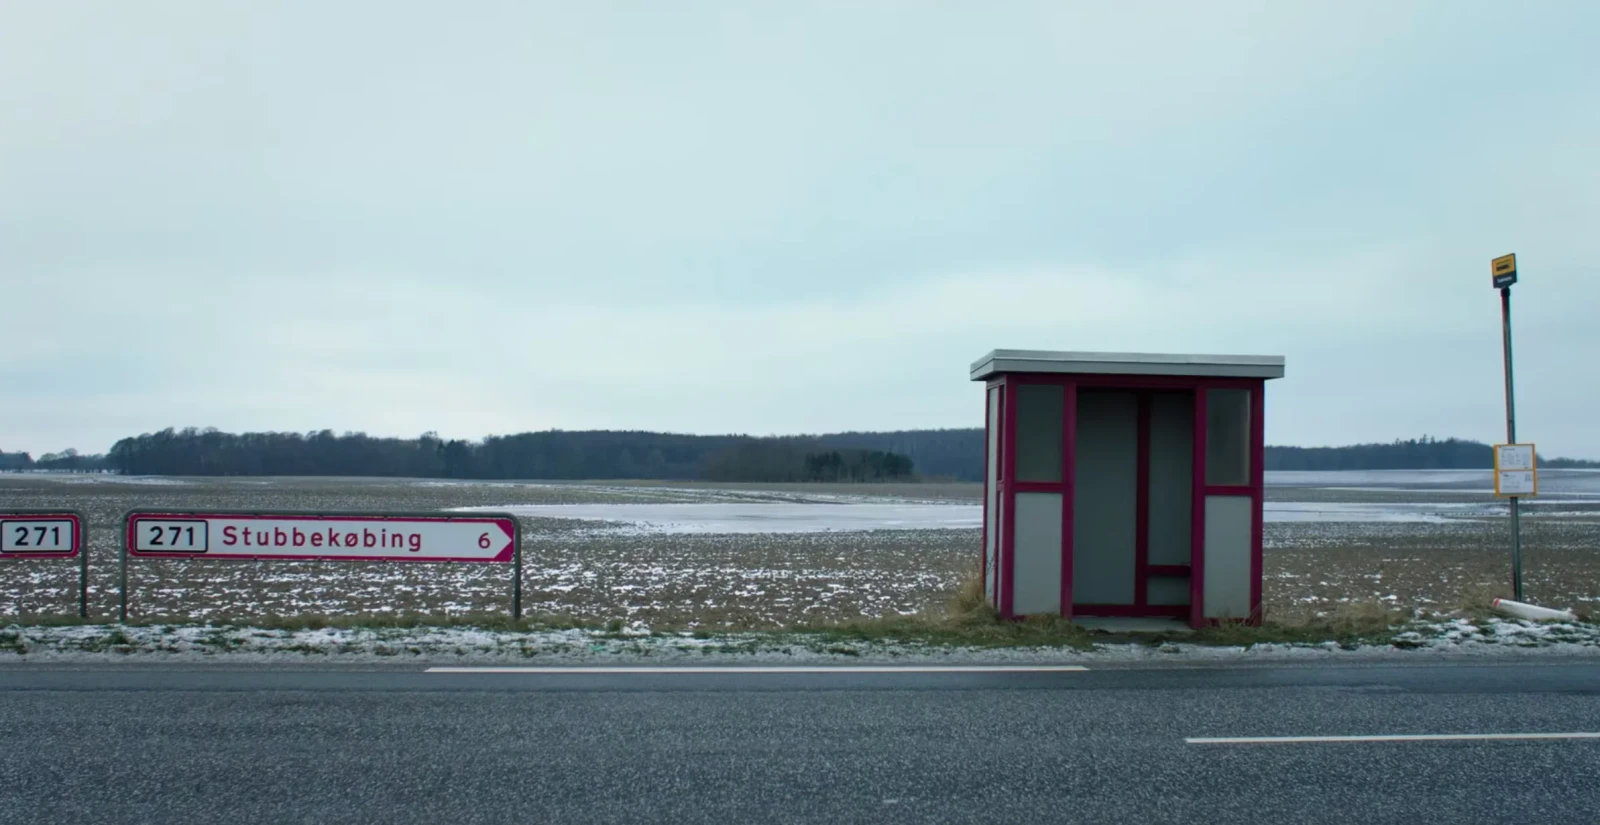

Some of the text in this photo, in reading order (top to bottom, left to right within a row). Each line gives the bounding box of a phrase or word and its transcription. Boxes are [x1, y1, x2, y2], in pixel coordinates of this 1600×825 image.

[14, 526, 60, 546] 271
[149, 525, 491, 552] 271 Stubbekøbing 6
